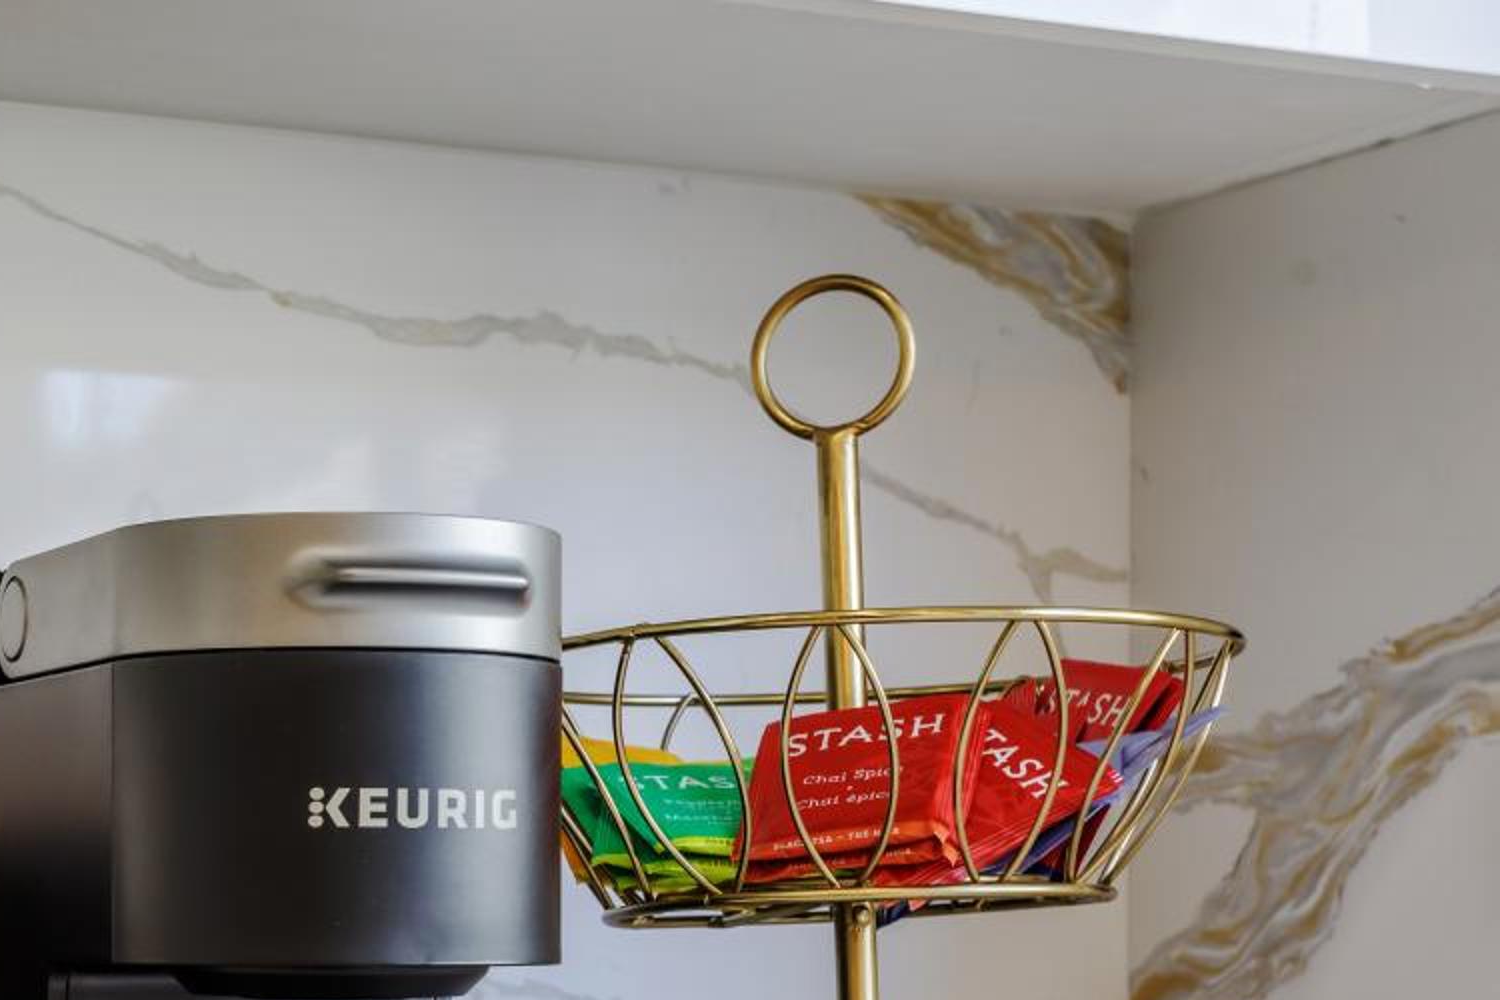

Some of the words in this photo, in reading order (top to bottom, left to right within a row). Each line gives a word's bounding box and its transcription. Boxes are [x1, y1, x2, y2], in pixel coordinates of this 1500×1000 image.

[787, 713, 946, 757] STASH
[619, 775, 736, 790] TAS
[803, 771, 847, 785] Chai
[853, 765, 903, 781] Spic
[982, 728, 1070, 799] TASH
[307, 786, 518, 829] KEURIG
